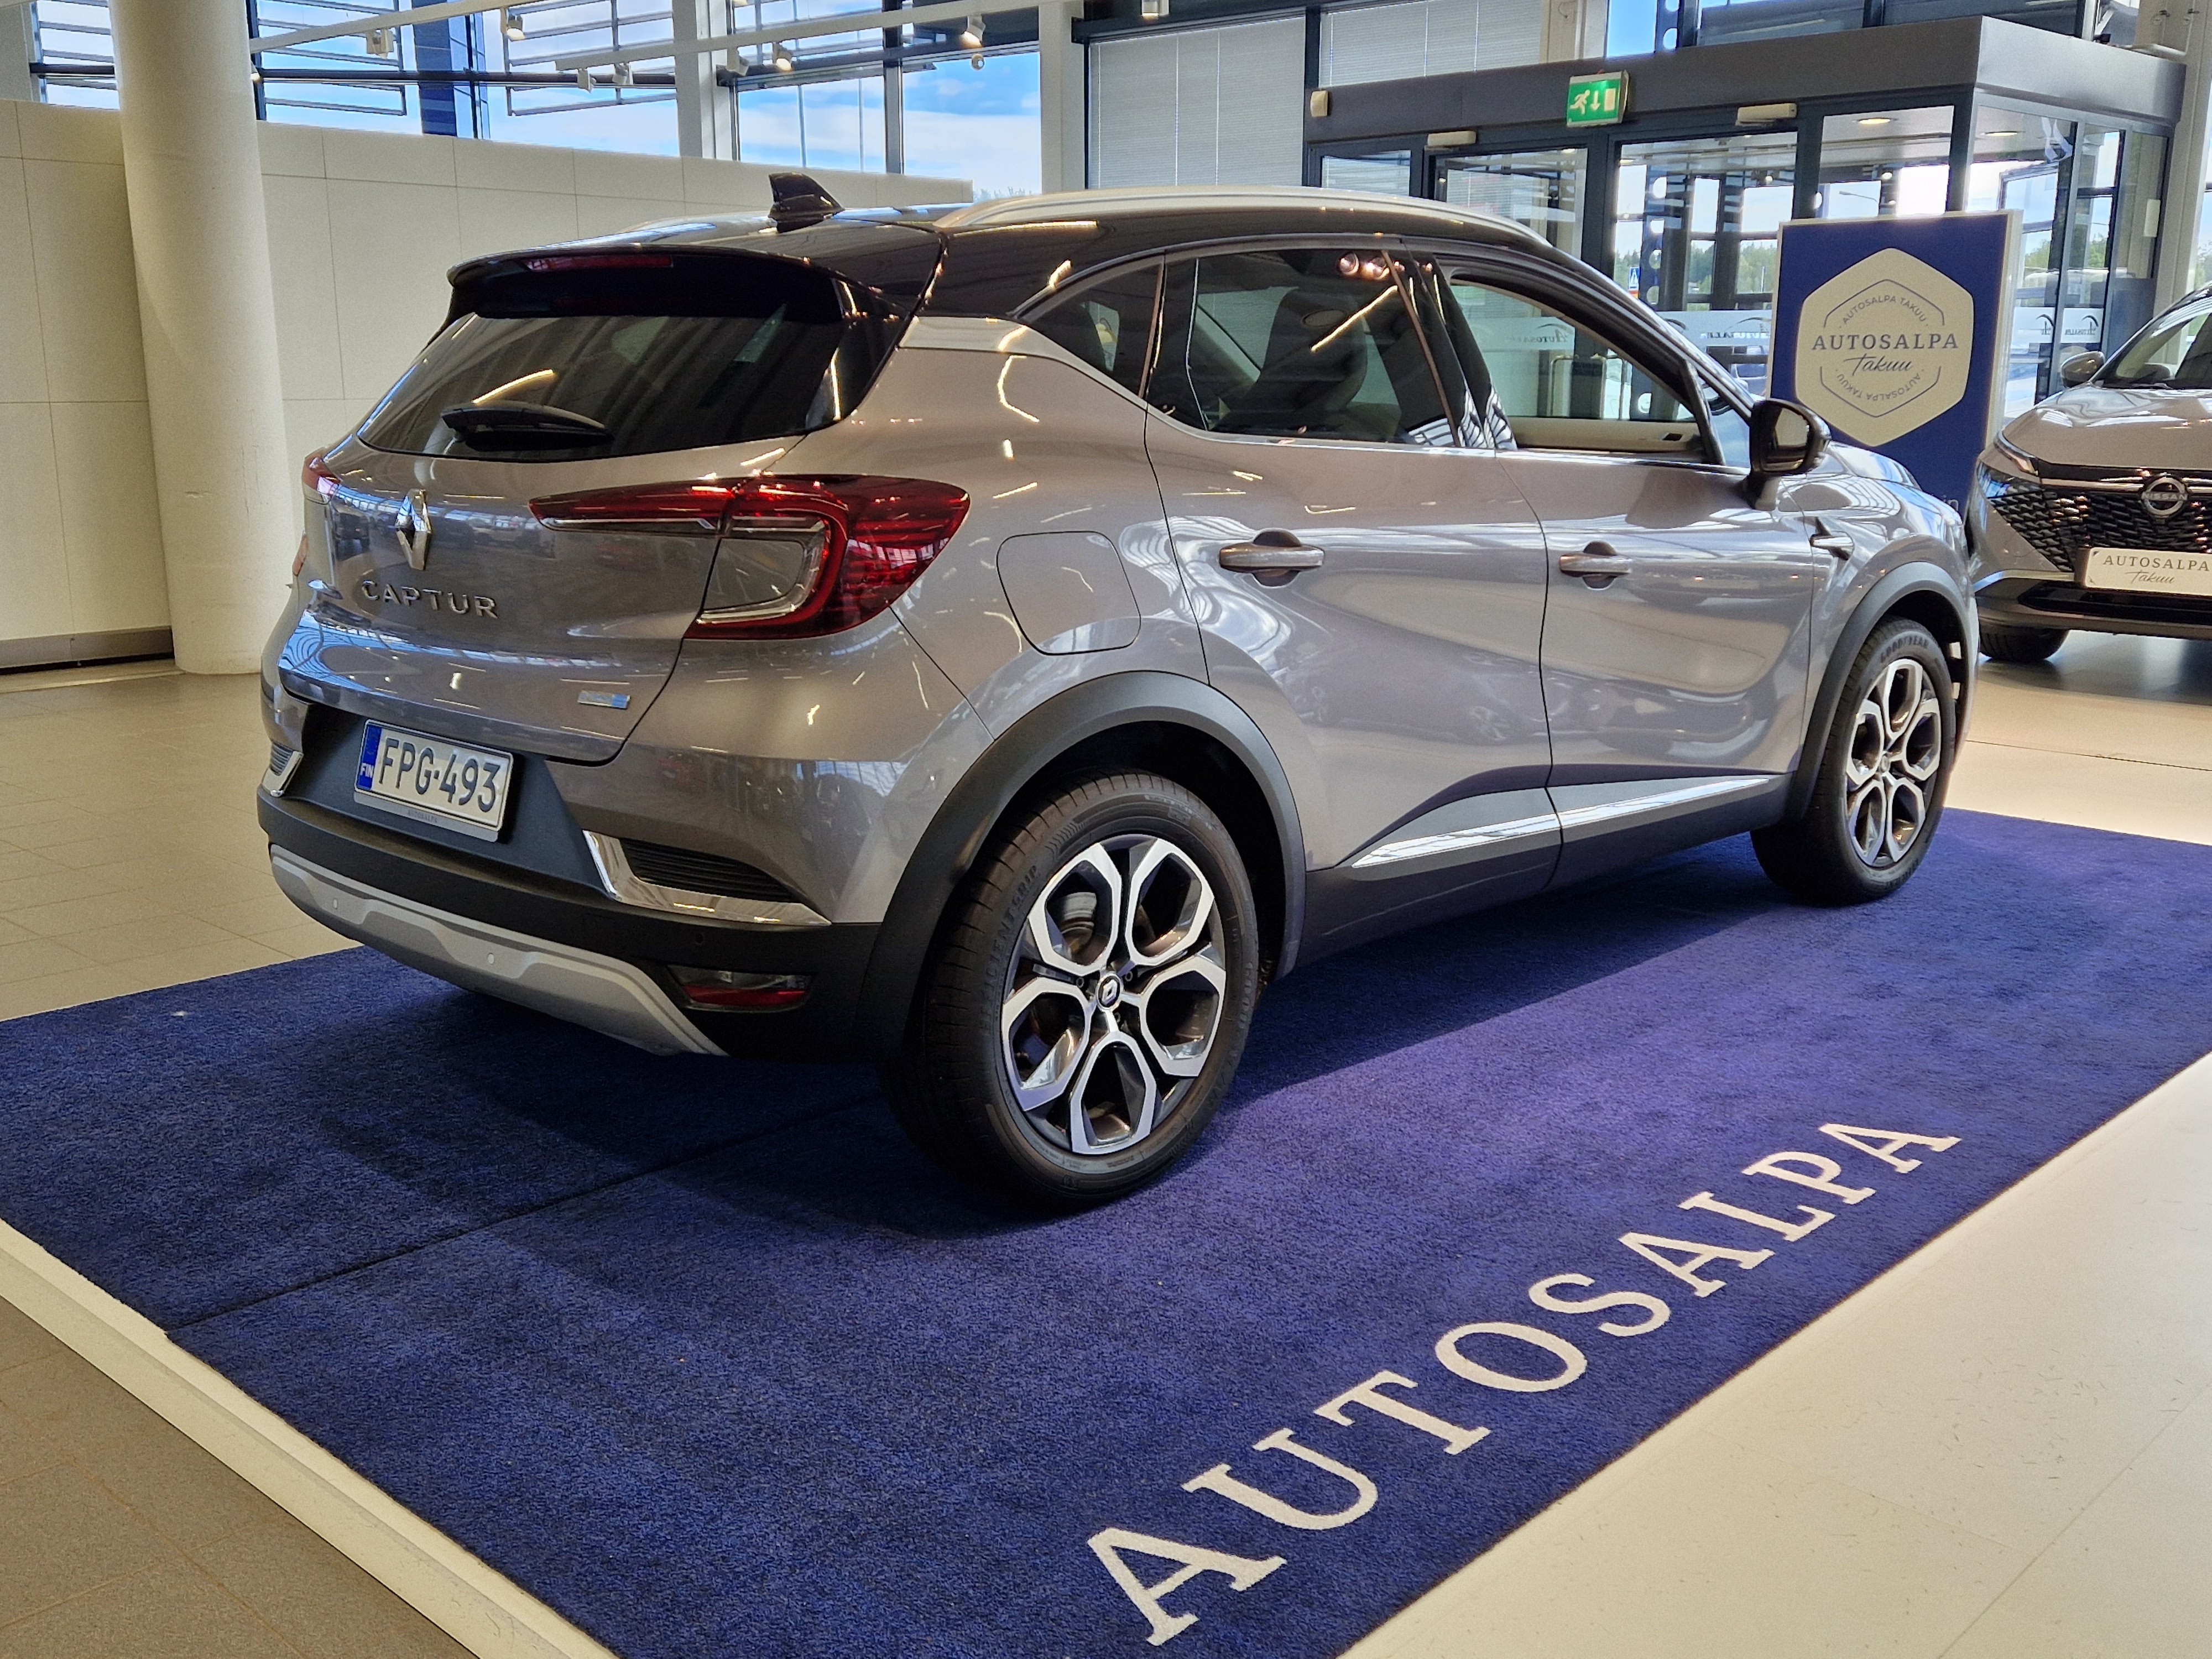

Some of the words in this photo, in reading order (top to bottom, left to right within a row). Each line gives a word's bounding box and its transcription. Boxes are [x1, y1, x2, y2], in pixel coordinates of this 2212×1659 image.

[1843, 295, 1896, 325] AUTOSALPA
[1900, 298, 1927, 322] TAKUU
[1812, 333, 1959, 351] AUTOSALPA
[1843, 353, 1912, 377] Takuu
[1837, 373, 1862, 398] TAKUU
[1867, 373, 1921, 401] AUTOSALPA
[2141, 491, 2188, 501] NISSAN
[2103, 555, 2210, 572] AUTOSALPA
[2125, 570, 2176, 585] Takuu
[361, 580, 498, 619] CAPTUR
[361, 762, 374, 779] FIN
[378, 737, 501, 812] FPG-493
[1087, 1122, 1963, 1648] AUTOSALPA
